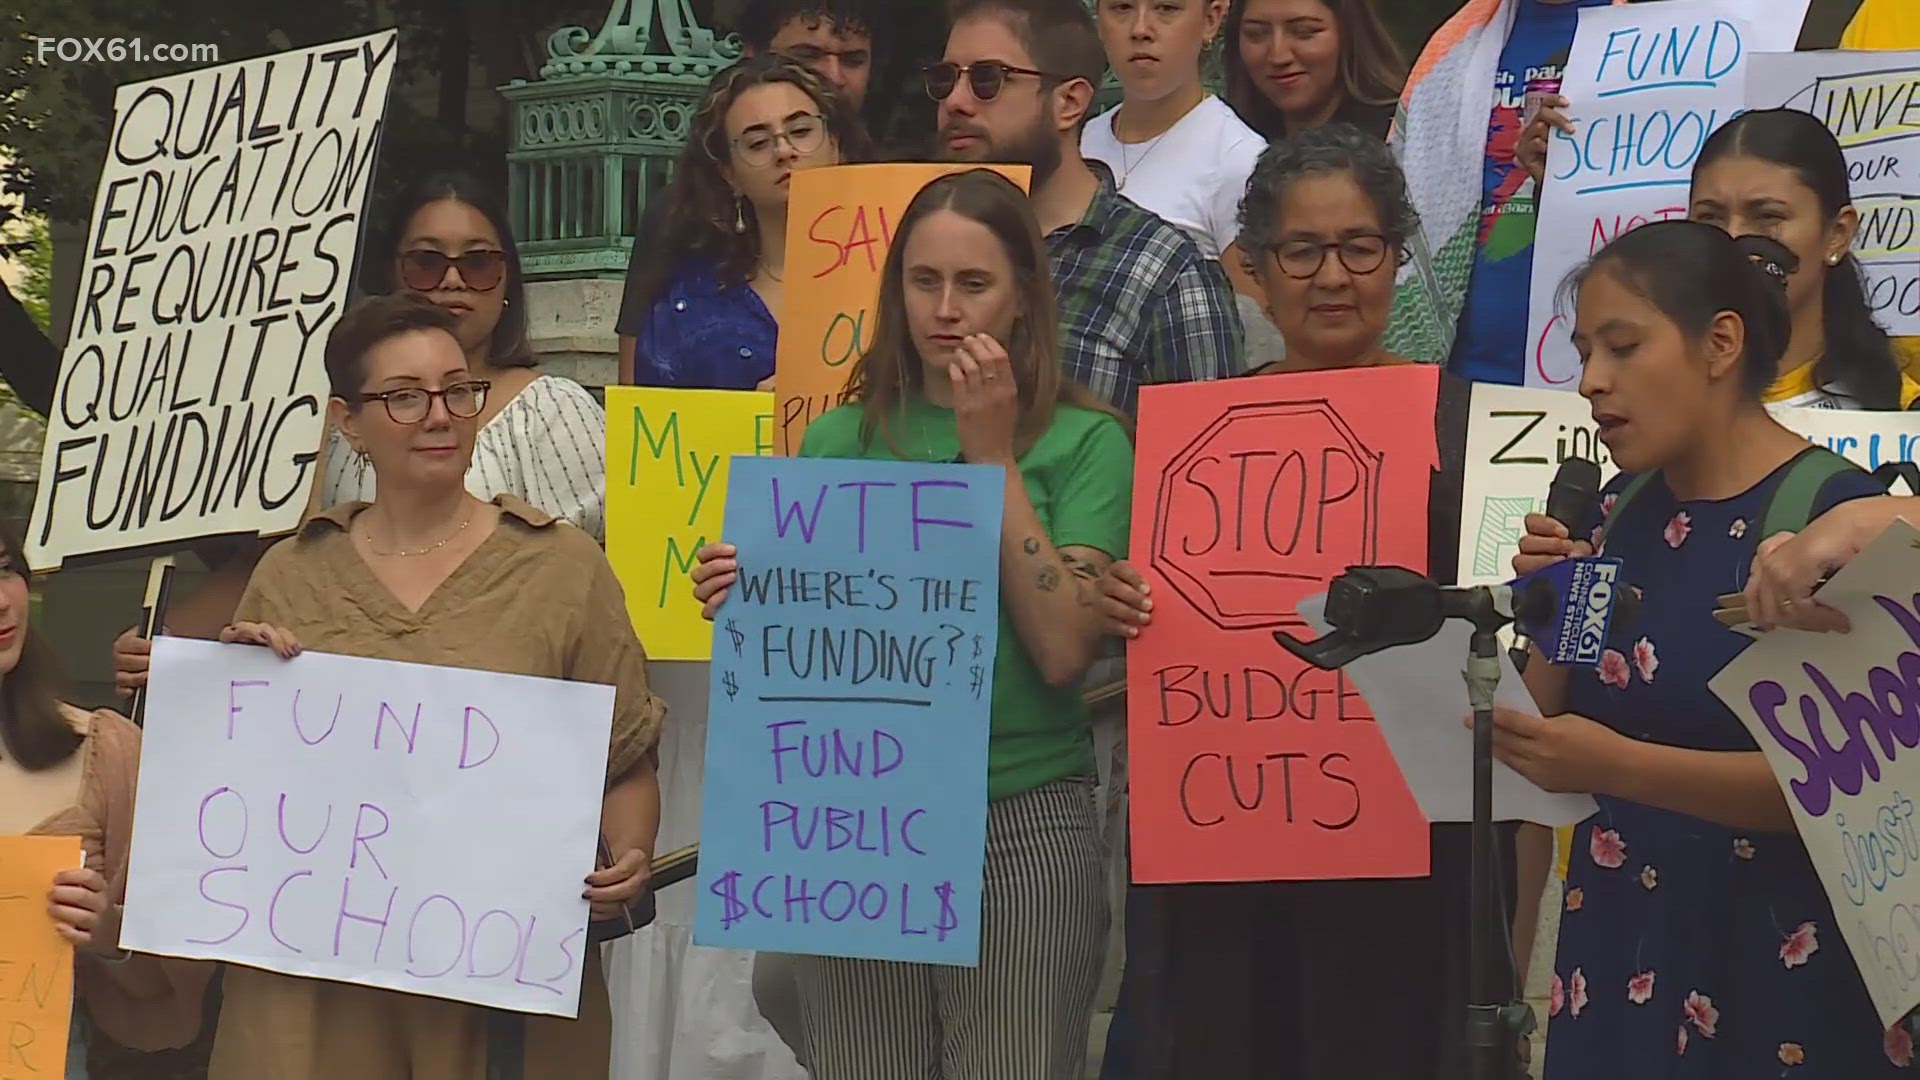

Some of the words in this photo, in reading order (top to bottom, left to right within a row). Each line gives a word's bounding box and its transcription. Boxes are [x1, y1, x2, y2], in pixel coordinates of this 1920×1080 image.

[1595, 20, 1741, 83] FUND
[114, 40, 398, 165] QUALITY
[93, 122, 380, 259] EDUCATION
[1858, 207, 1914, 251] ND
[78, 214, 355, 339] REQUIRES
[61, 301, 336, 430] QUALITY
[41, 395, 319, 547] FUNDING
[629, 406, 720, 526] My
[1182, 446, 1360, 557] STOP
[771, 477, 973, 554] WTF
[738, 566, 899, 611] WHERE'S
[908, 575, 982, 614] THE
[1566, 562, 1594, 662] CONNECTICUT'S
[1568, 562, 1583, 602] NEWS
[1576, 563, 1618, 663] FOX61
[761, 622, 965, 689] FUNDING?
[1557, 604, 1577, 662] STATION
[227, 680, 500, 769] FUND
[766, 720, 905, 784] FUND
[199, 786, 390, 879] OUR
[759, 800, 927, 857] PUBLIC
[1180, 752, 1361, 830] CUTS
[186, 865, 585, 996] SCHOOLS
